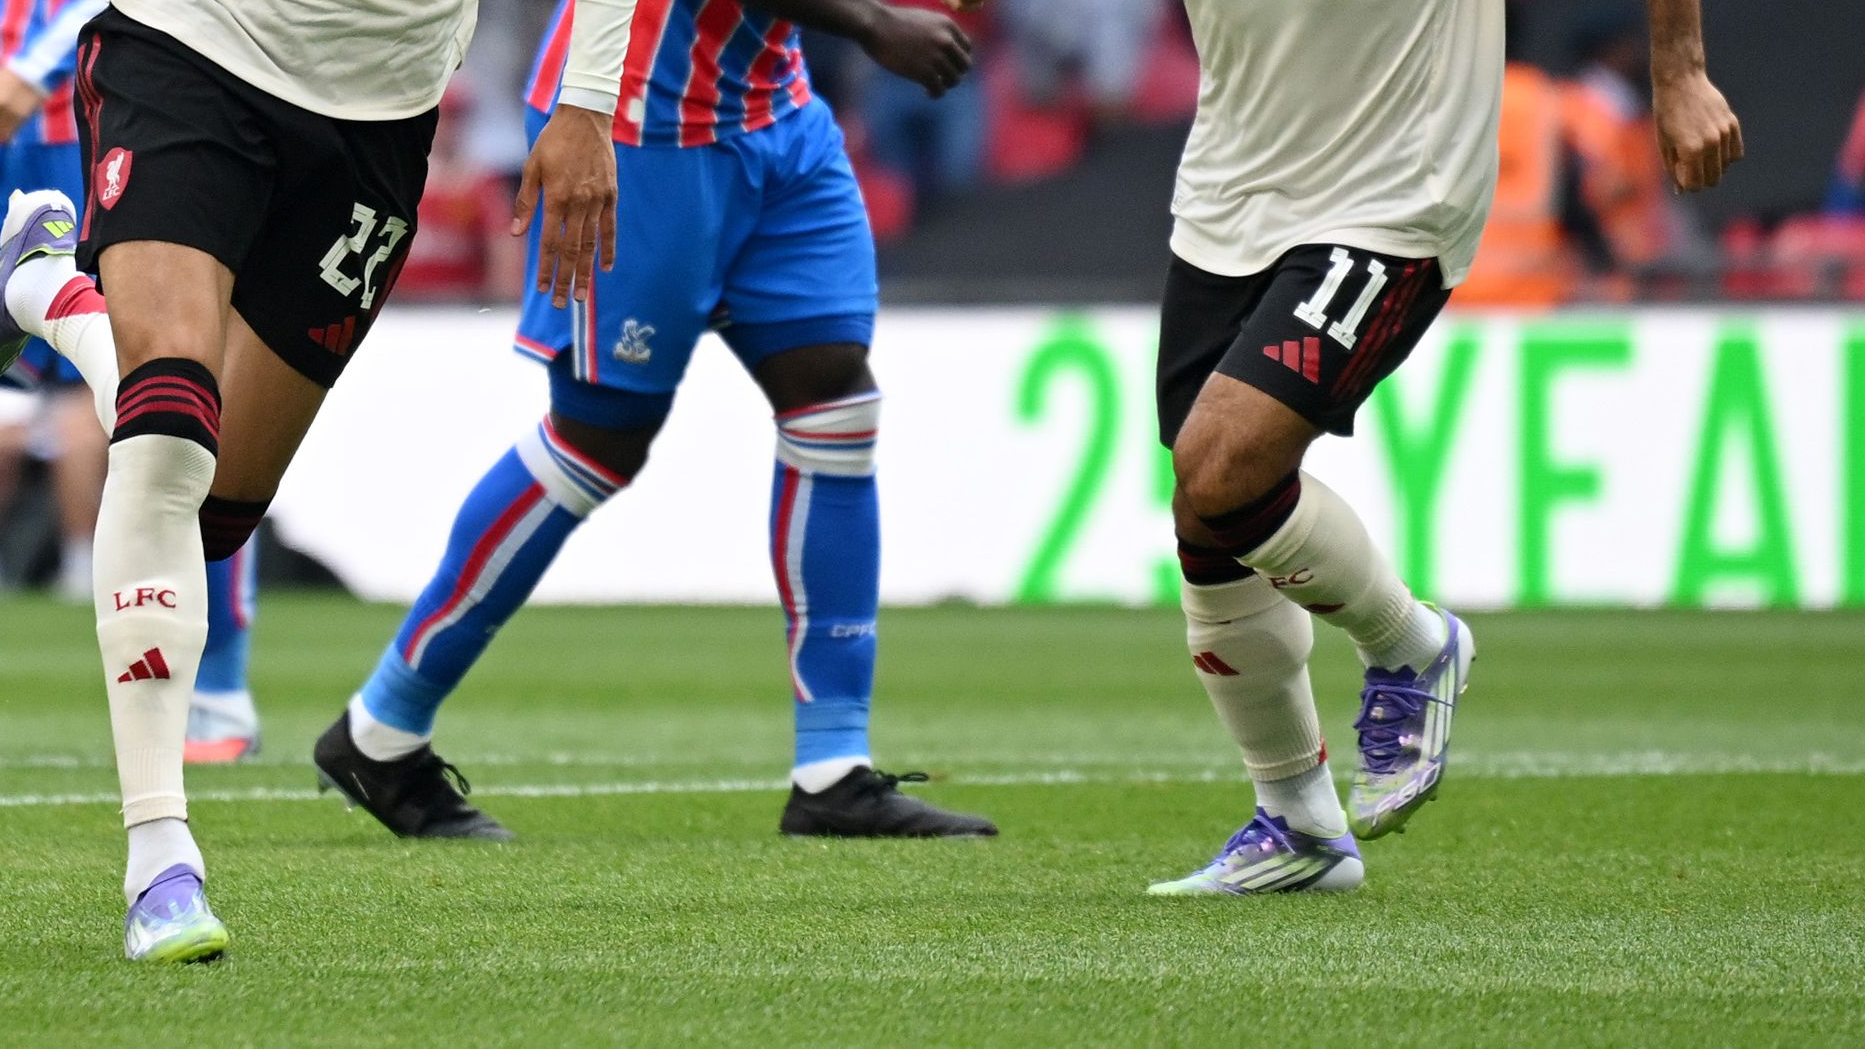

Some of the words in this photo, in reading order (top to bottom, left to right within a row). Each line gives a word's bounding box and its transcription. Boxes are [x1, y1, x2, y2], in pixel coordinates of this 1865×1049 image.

[319, 201, 408, 310] 22
[1293, 246, 1388, 350] 11
[113, 587, 176, 612] LFC
